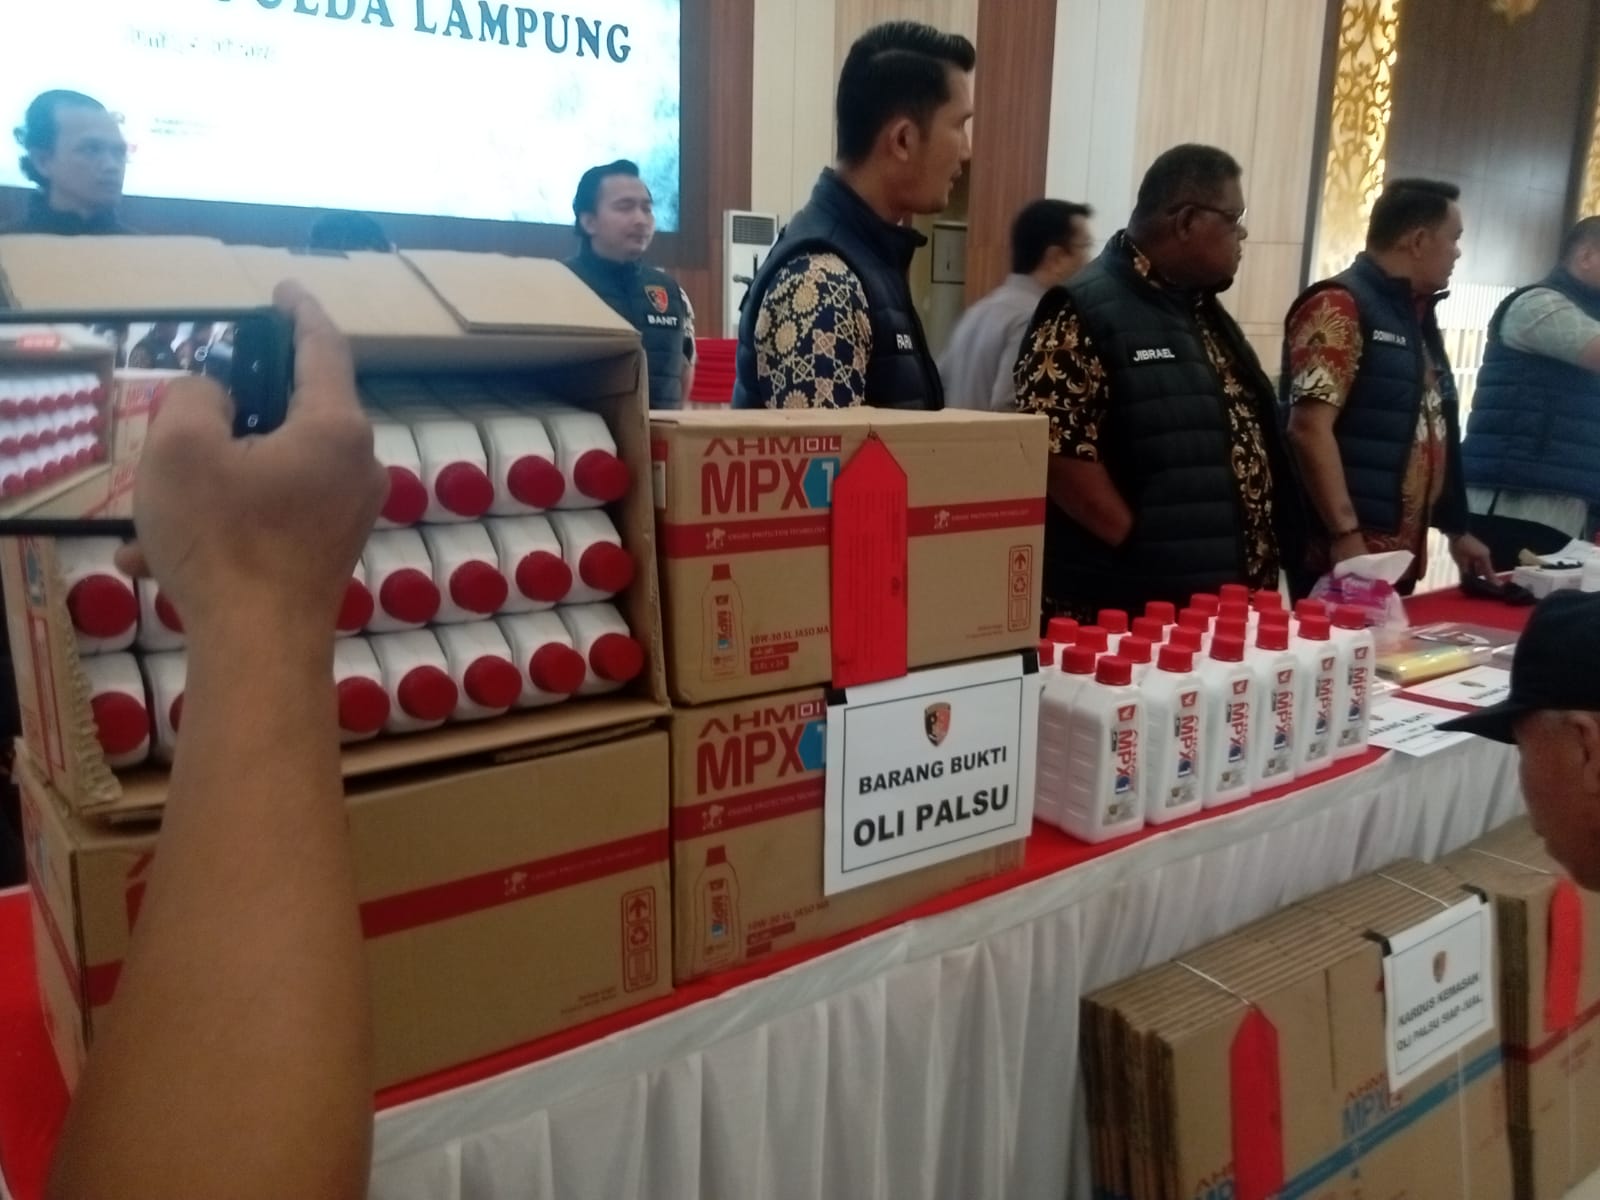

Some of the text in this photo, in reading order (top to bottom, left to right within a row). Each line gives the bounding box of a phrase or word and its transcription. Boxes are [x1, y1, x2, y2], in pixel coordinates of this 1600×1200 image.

[414, 0, 631, 63] LAMPUNG
[1133, 347, 1176, 362] JIBRAEL
[859, 745, 1007, 795] BARANG BUKTI
[1116, 730, 1133, 776] MPX
[853, 784, 1009, 847] OLI PALSU
